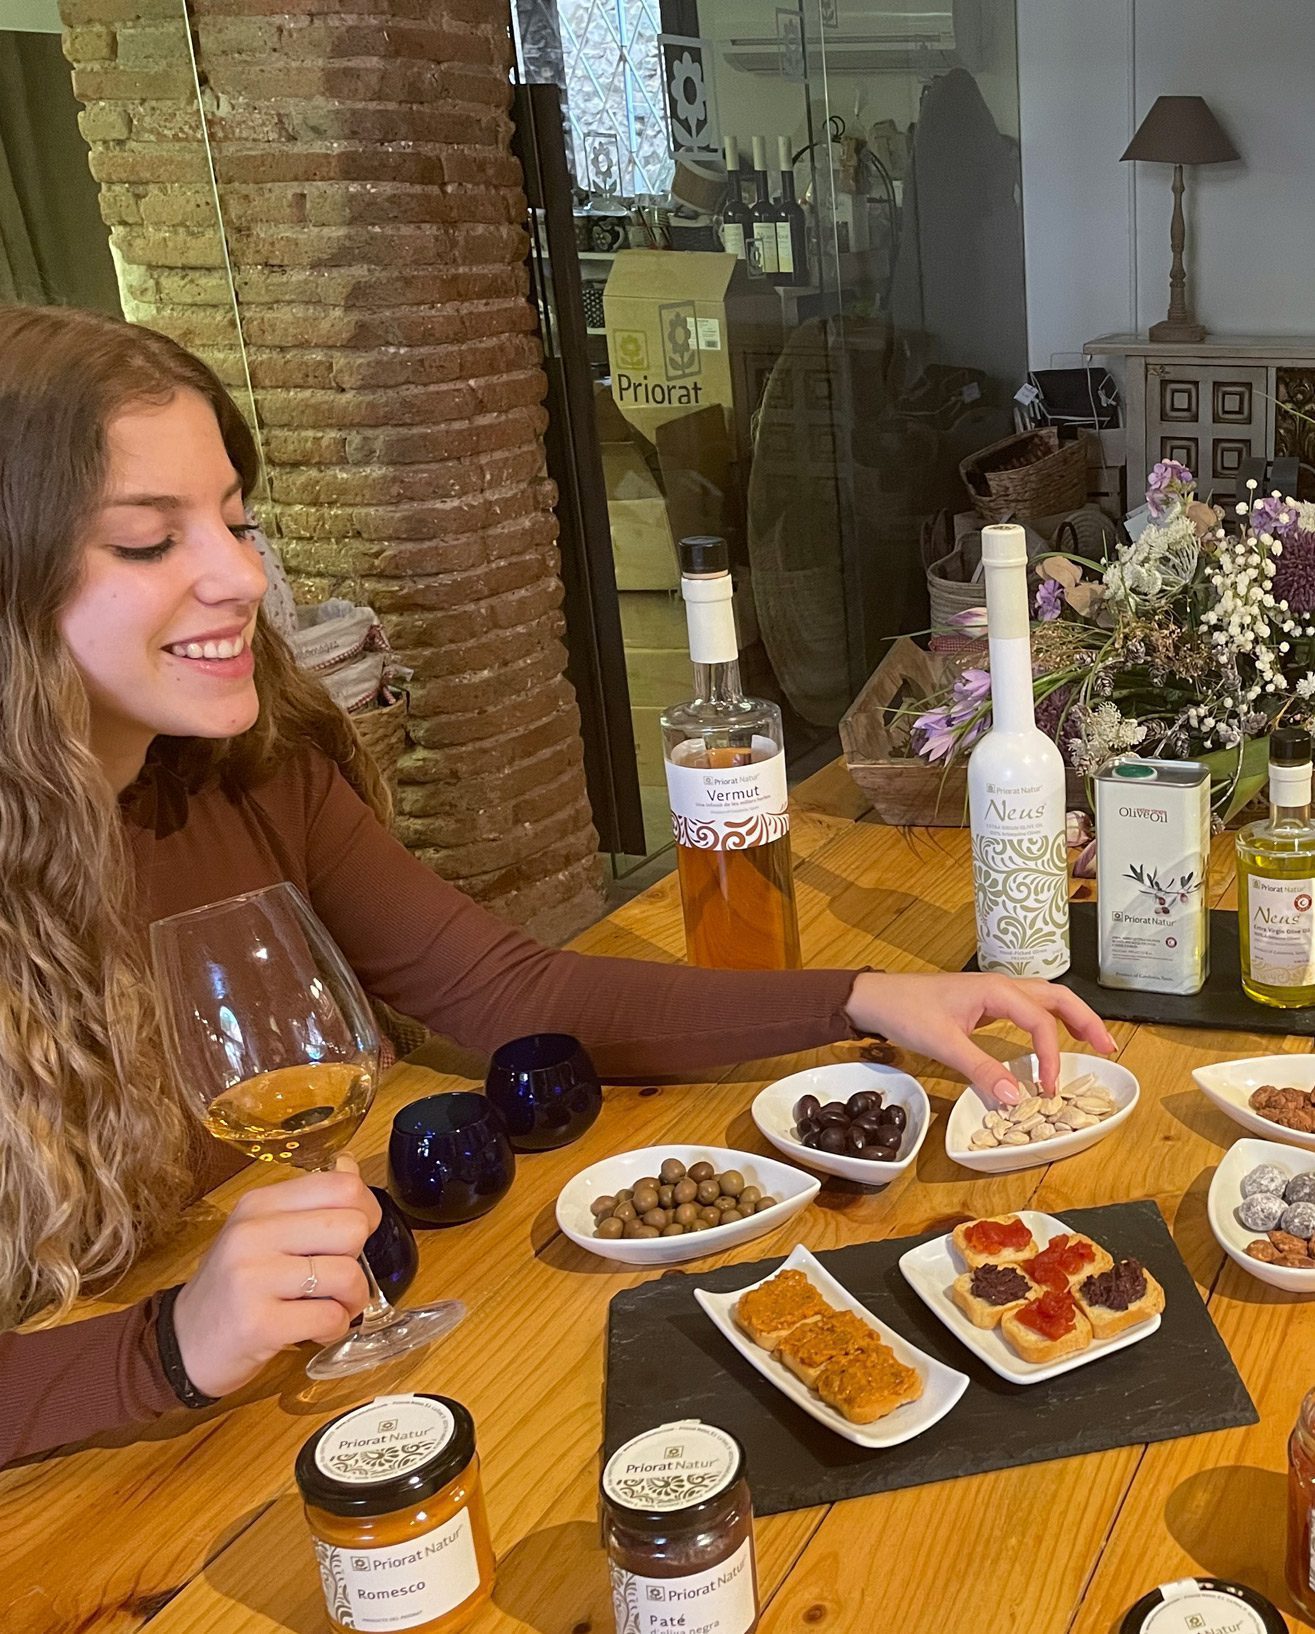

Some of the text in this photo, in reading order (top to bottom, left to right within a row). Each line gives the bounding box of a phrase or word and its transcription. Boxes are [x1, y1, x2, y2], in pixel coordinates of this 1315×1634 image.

[617, 373, 702, 405] Priorat
[706, 786, 760, 802] Vermut
[984, 799, 1045, 822] Neus
[1124, 914, 1175, 927] Priorat Natur
[1253, 906, 1300, 925] Neus
[338, 1436, 387, 1449] Priorat
[388, 1427, 432, 1442] Natur
[625, 1462, 673, 1474] Priorat
[674, 1459, 717, 1471] Natur
[373, 1524, 463, 1571] Priorat Natur
[668, 1556, 746, 1602] Priorat Natur
[357, 1581, 426, 1600] Romesco
[649, 1613, 686, 1627] Paté
[689, 1619, 720, 1634] negra
